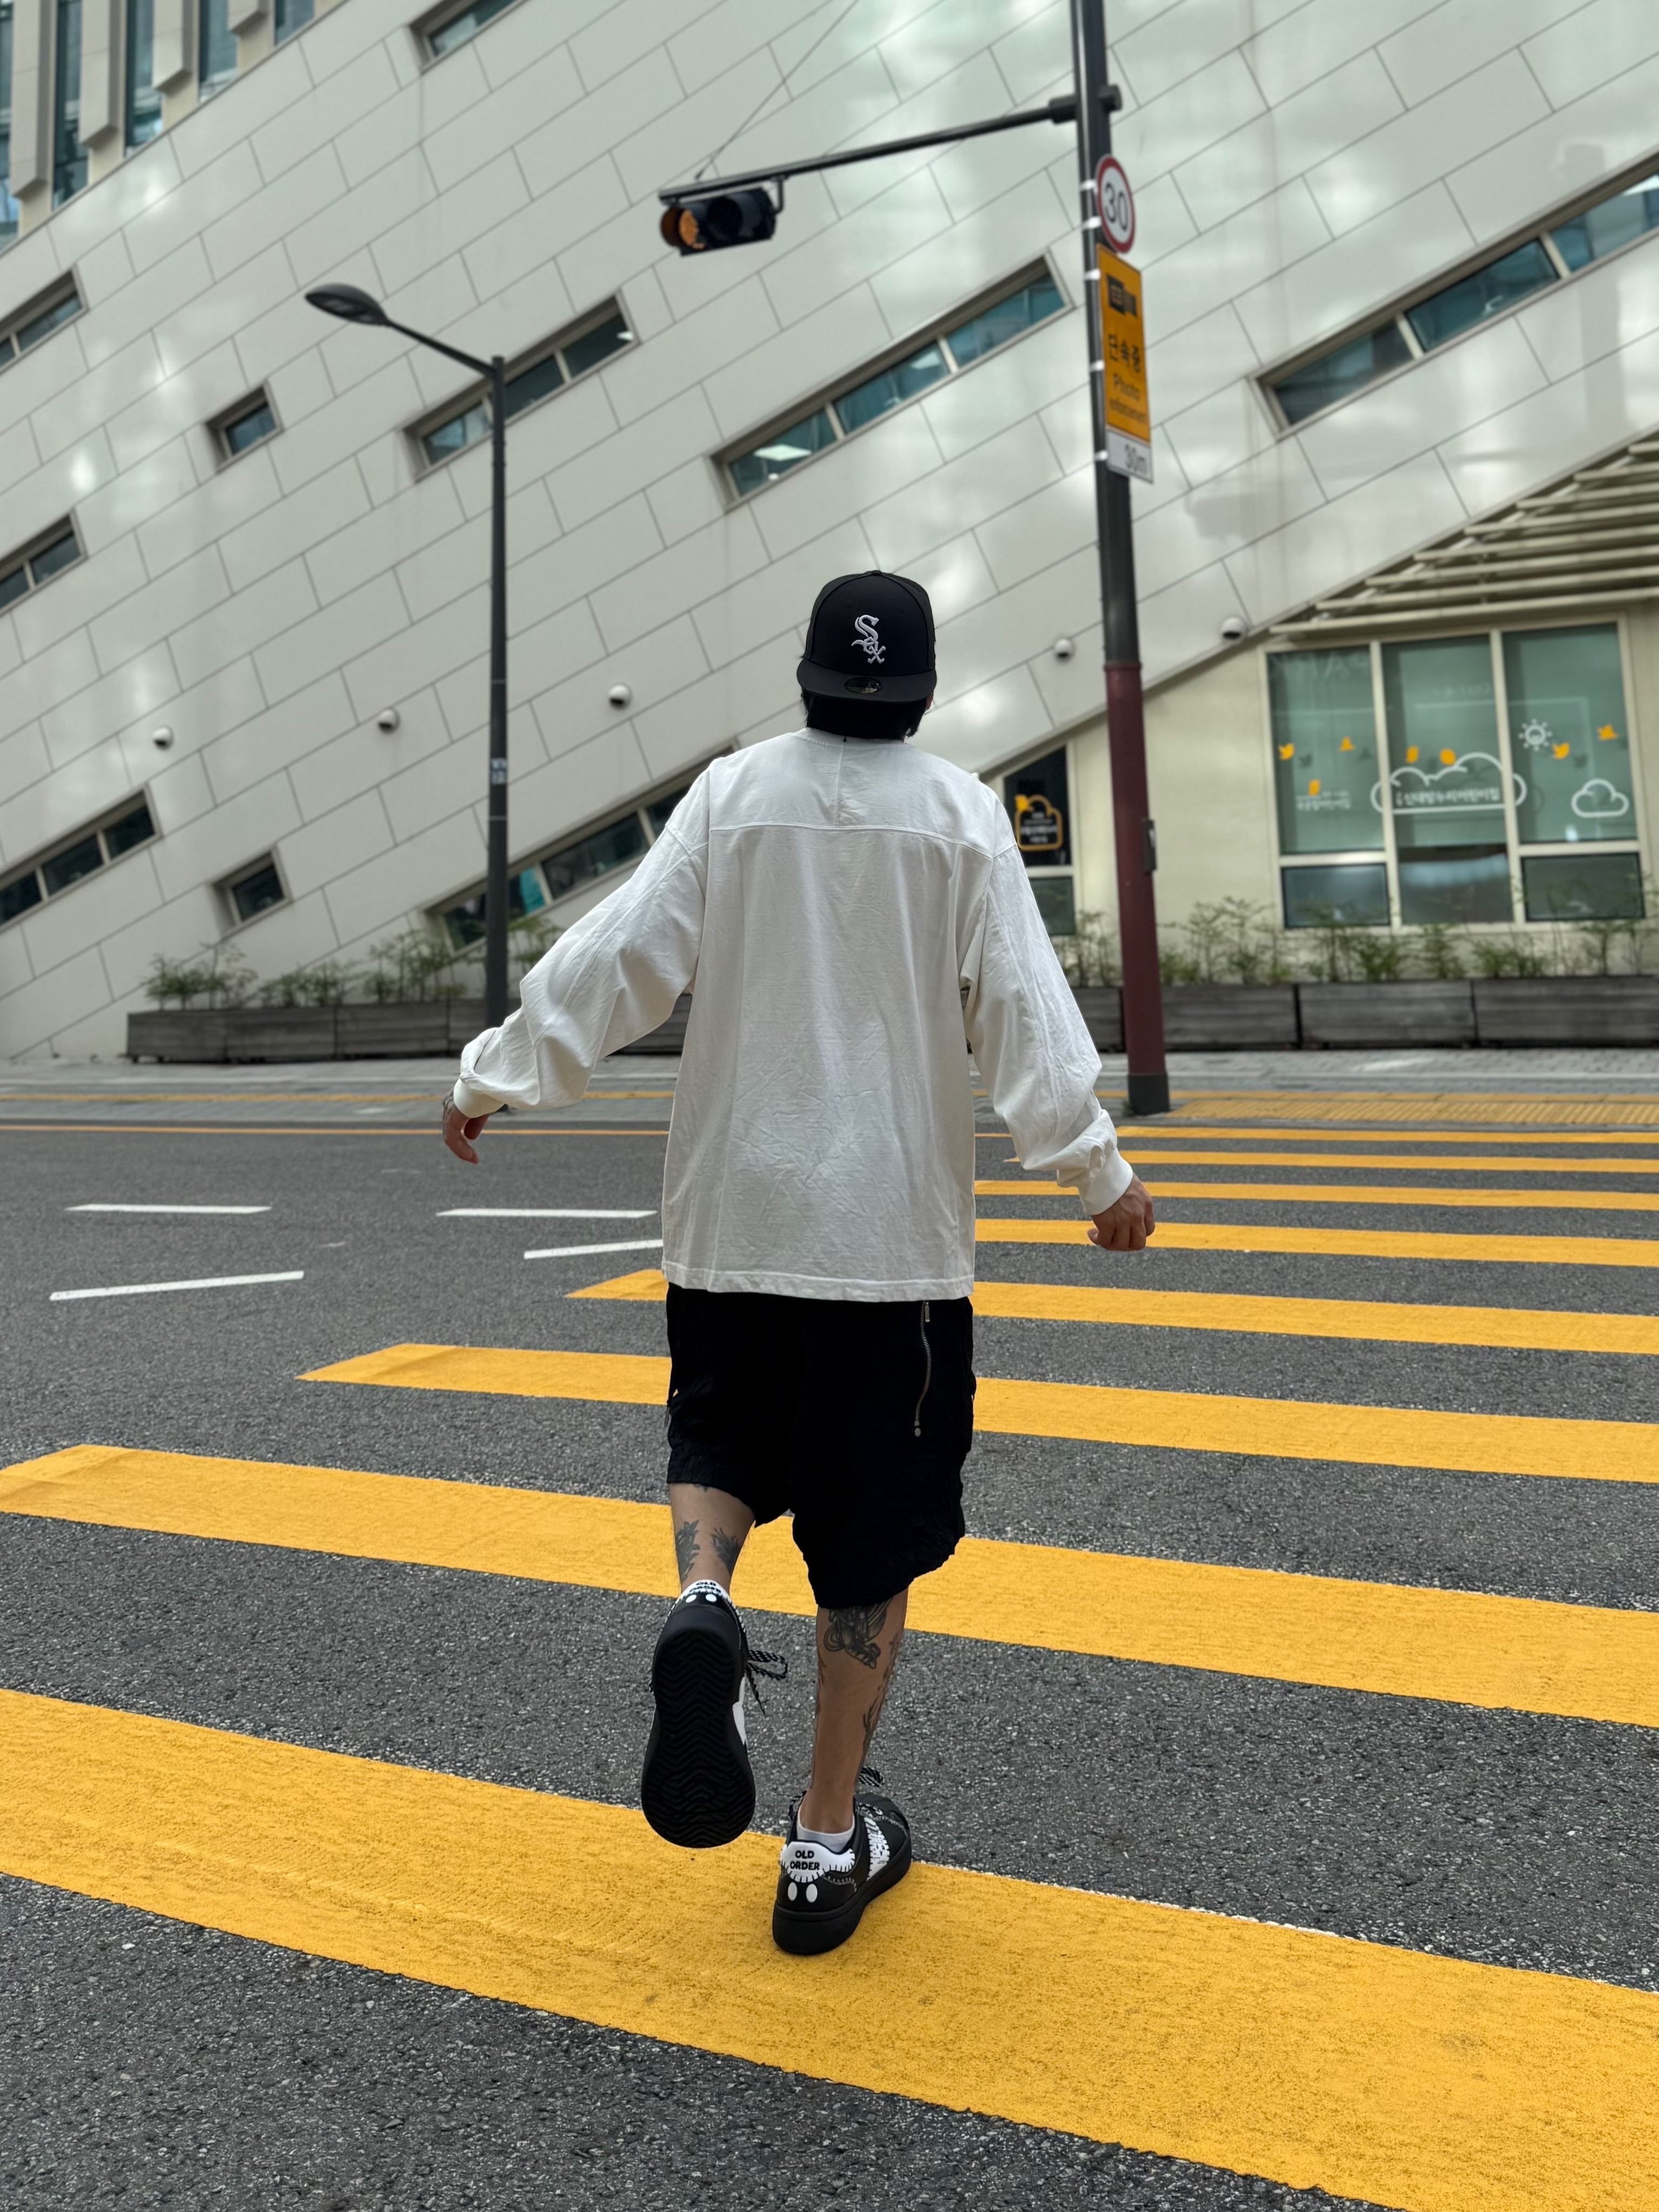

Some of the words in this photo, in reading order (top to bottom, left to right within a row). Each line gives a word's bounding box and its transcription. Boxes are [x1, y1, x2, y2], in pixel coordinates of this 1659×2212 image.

[1105, 182, 1128, 231] 30
[795, 1850, 814, 1859] OLD
[790, 1862, 820, 1870] ORDER
